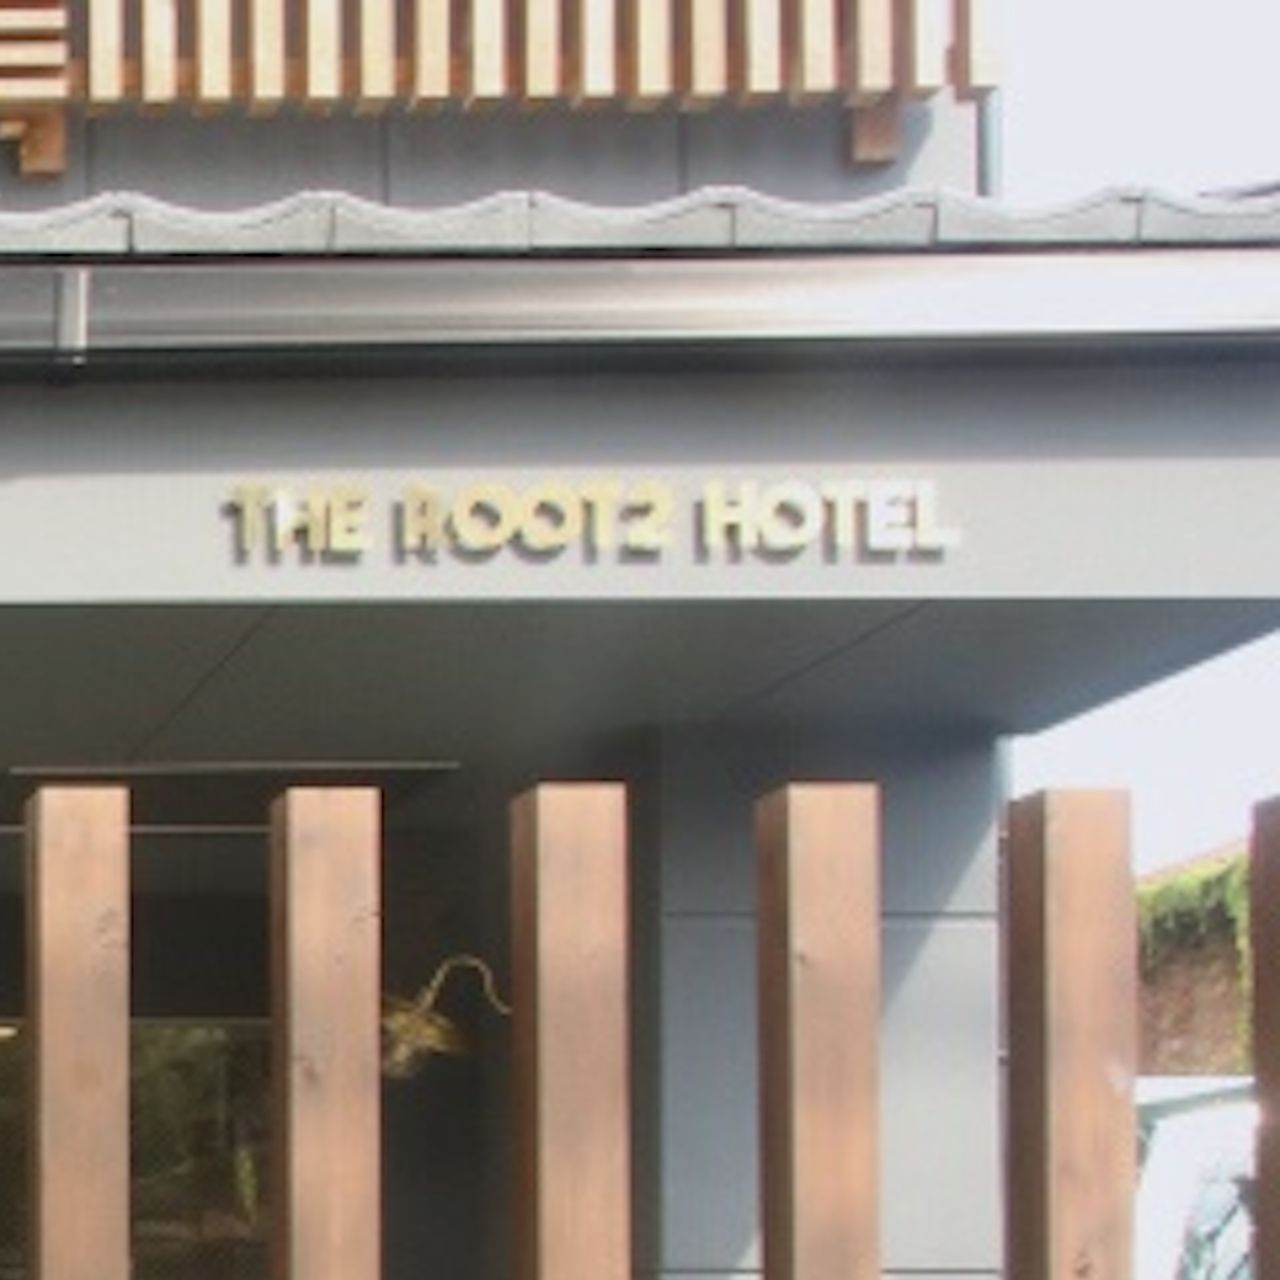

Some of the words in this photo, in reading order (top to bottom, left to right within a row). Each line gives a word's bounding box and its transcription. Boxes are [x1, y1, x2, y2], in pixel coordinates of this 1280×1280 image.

[220, 482, 372, 564] THE
[391, 479, 677, 564] ROOT2
[692, 476, 963, 564] HOTEL
